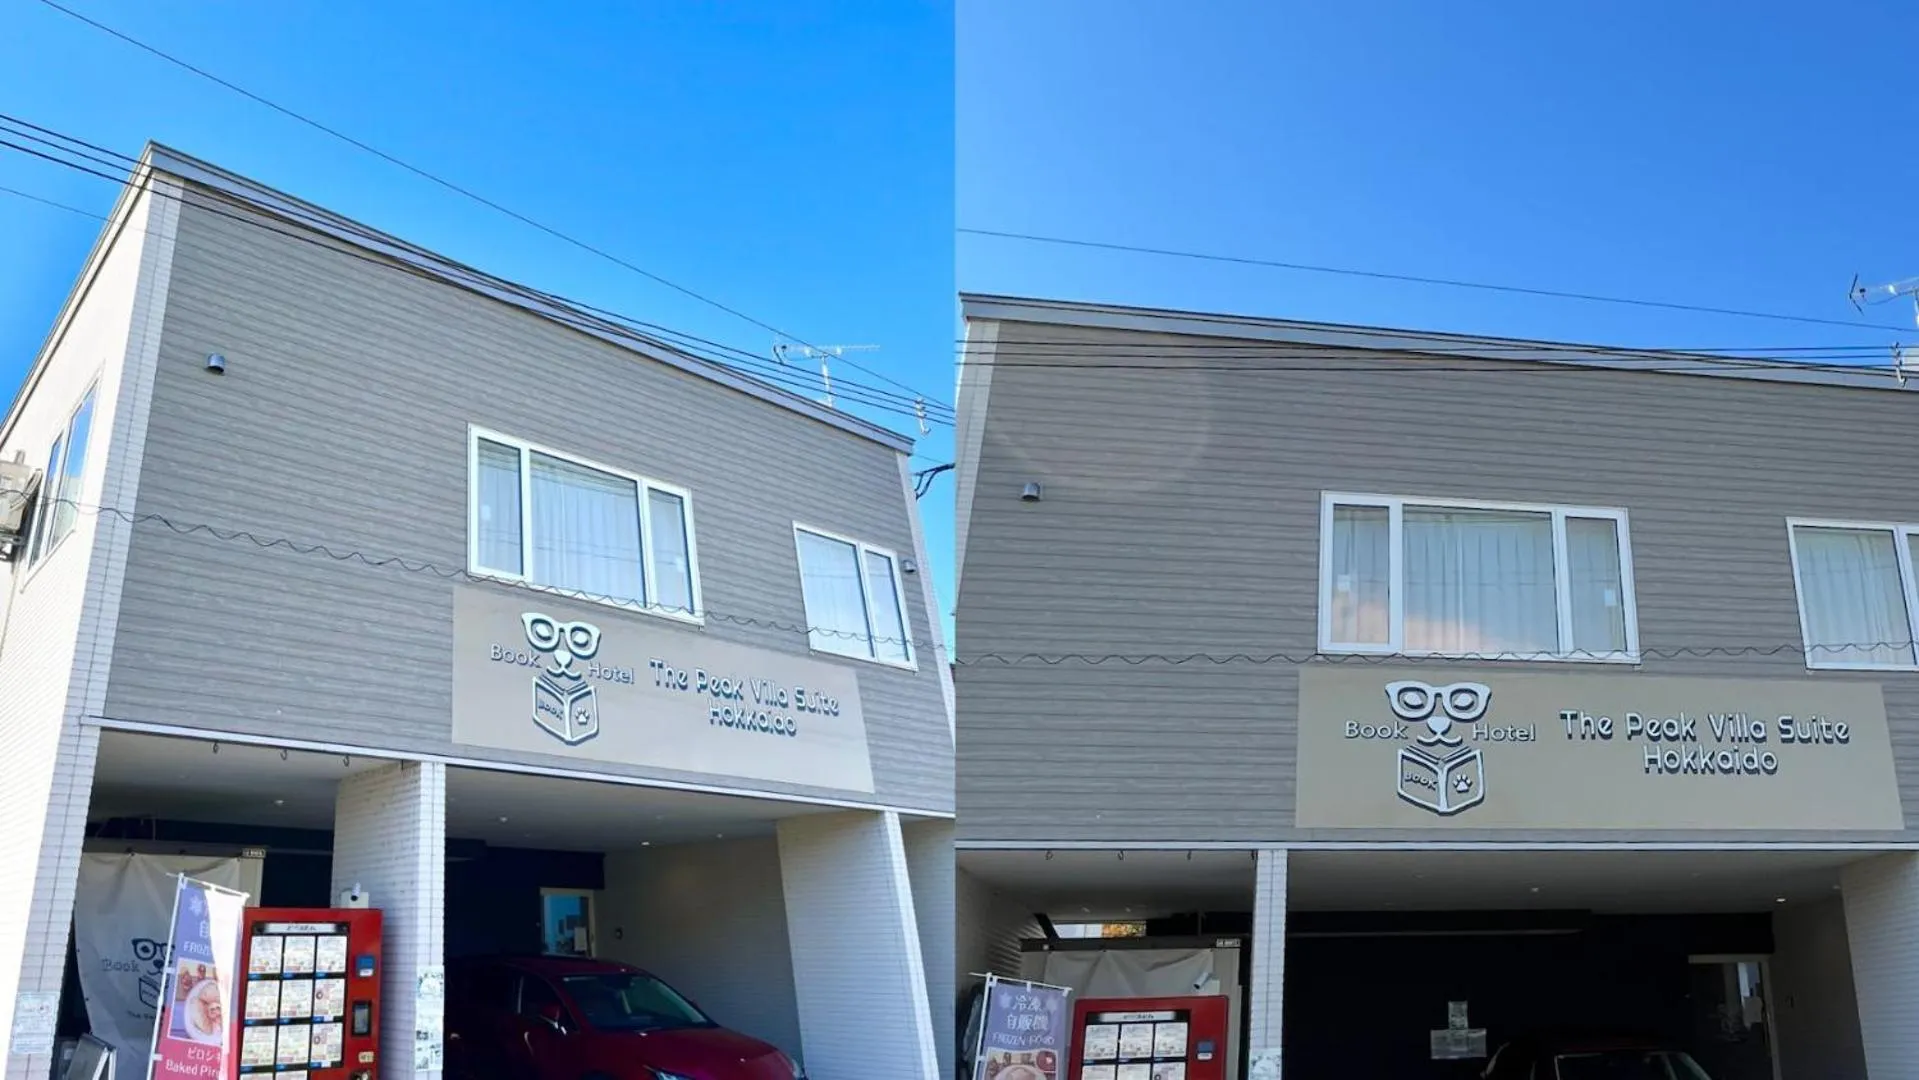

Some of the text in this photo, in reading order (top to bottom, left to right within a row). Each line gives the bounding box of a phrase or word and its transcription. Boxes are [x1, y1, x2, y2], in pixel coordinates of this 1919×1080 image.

[490, 643, 635, 685] Book Hotel
[650, 658, 840, 717] The Peak Villa Suite
[708, 699, 798, 737] Hokkaido
[1344, 720, 1536, 742] Book Hotel
[1559, 710, 1850, 745] The Peak Villa Suite
[1643, 743, 1779, 776] Hokkaido
